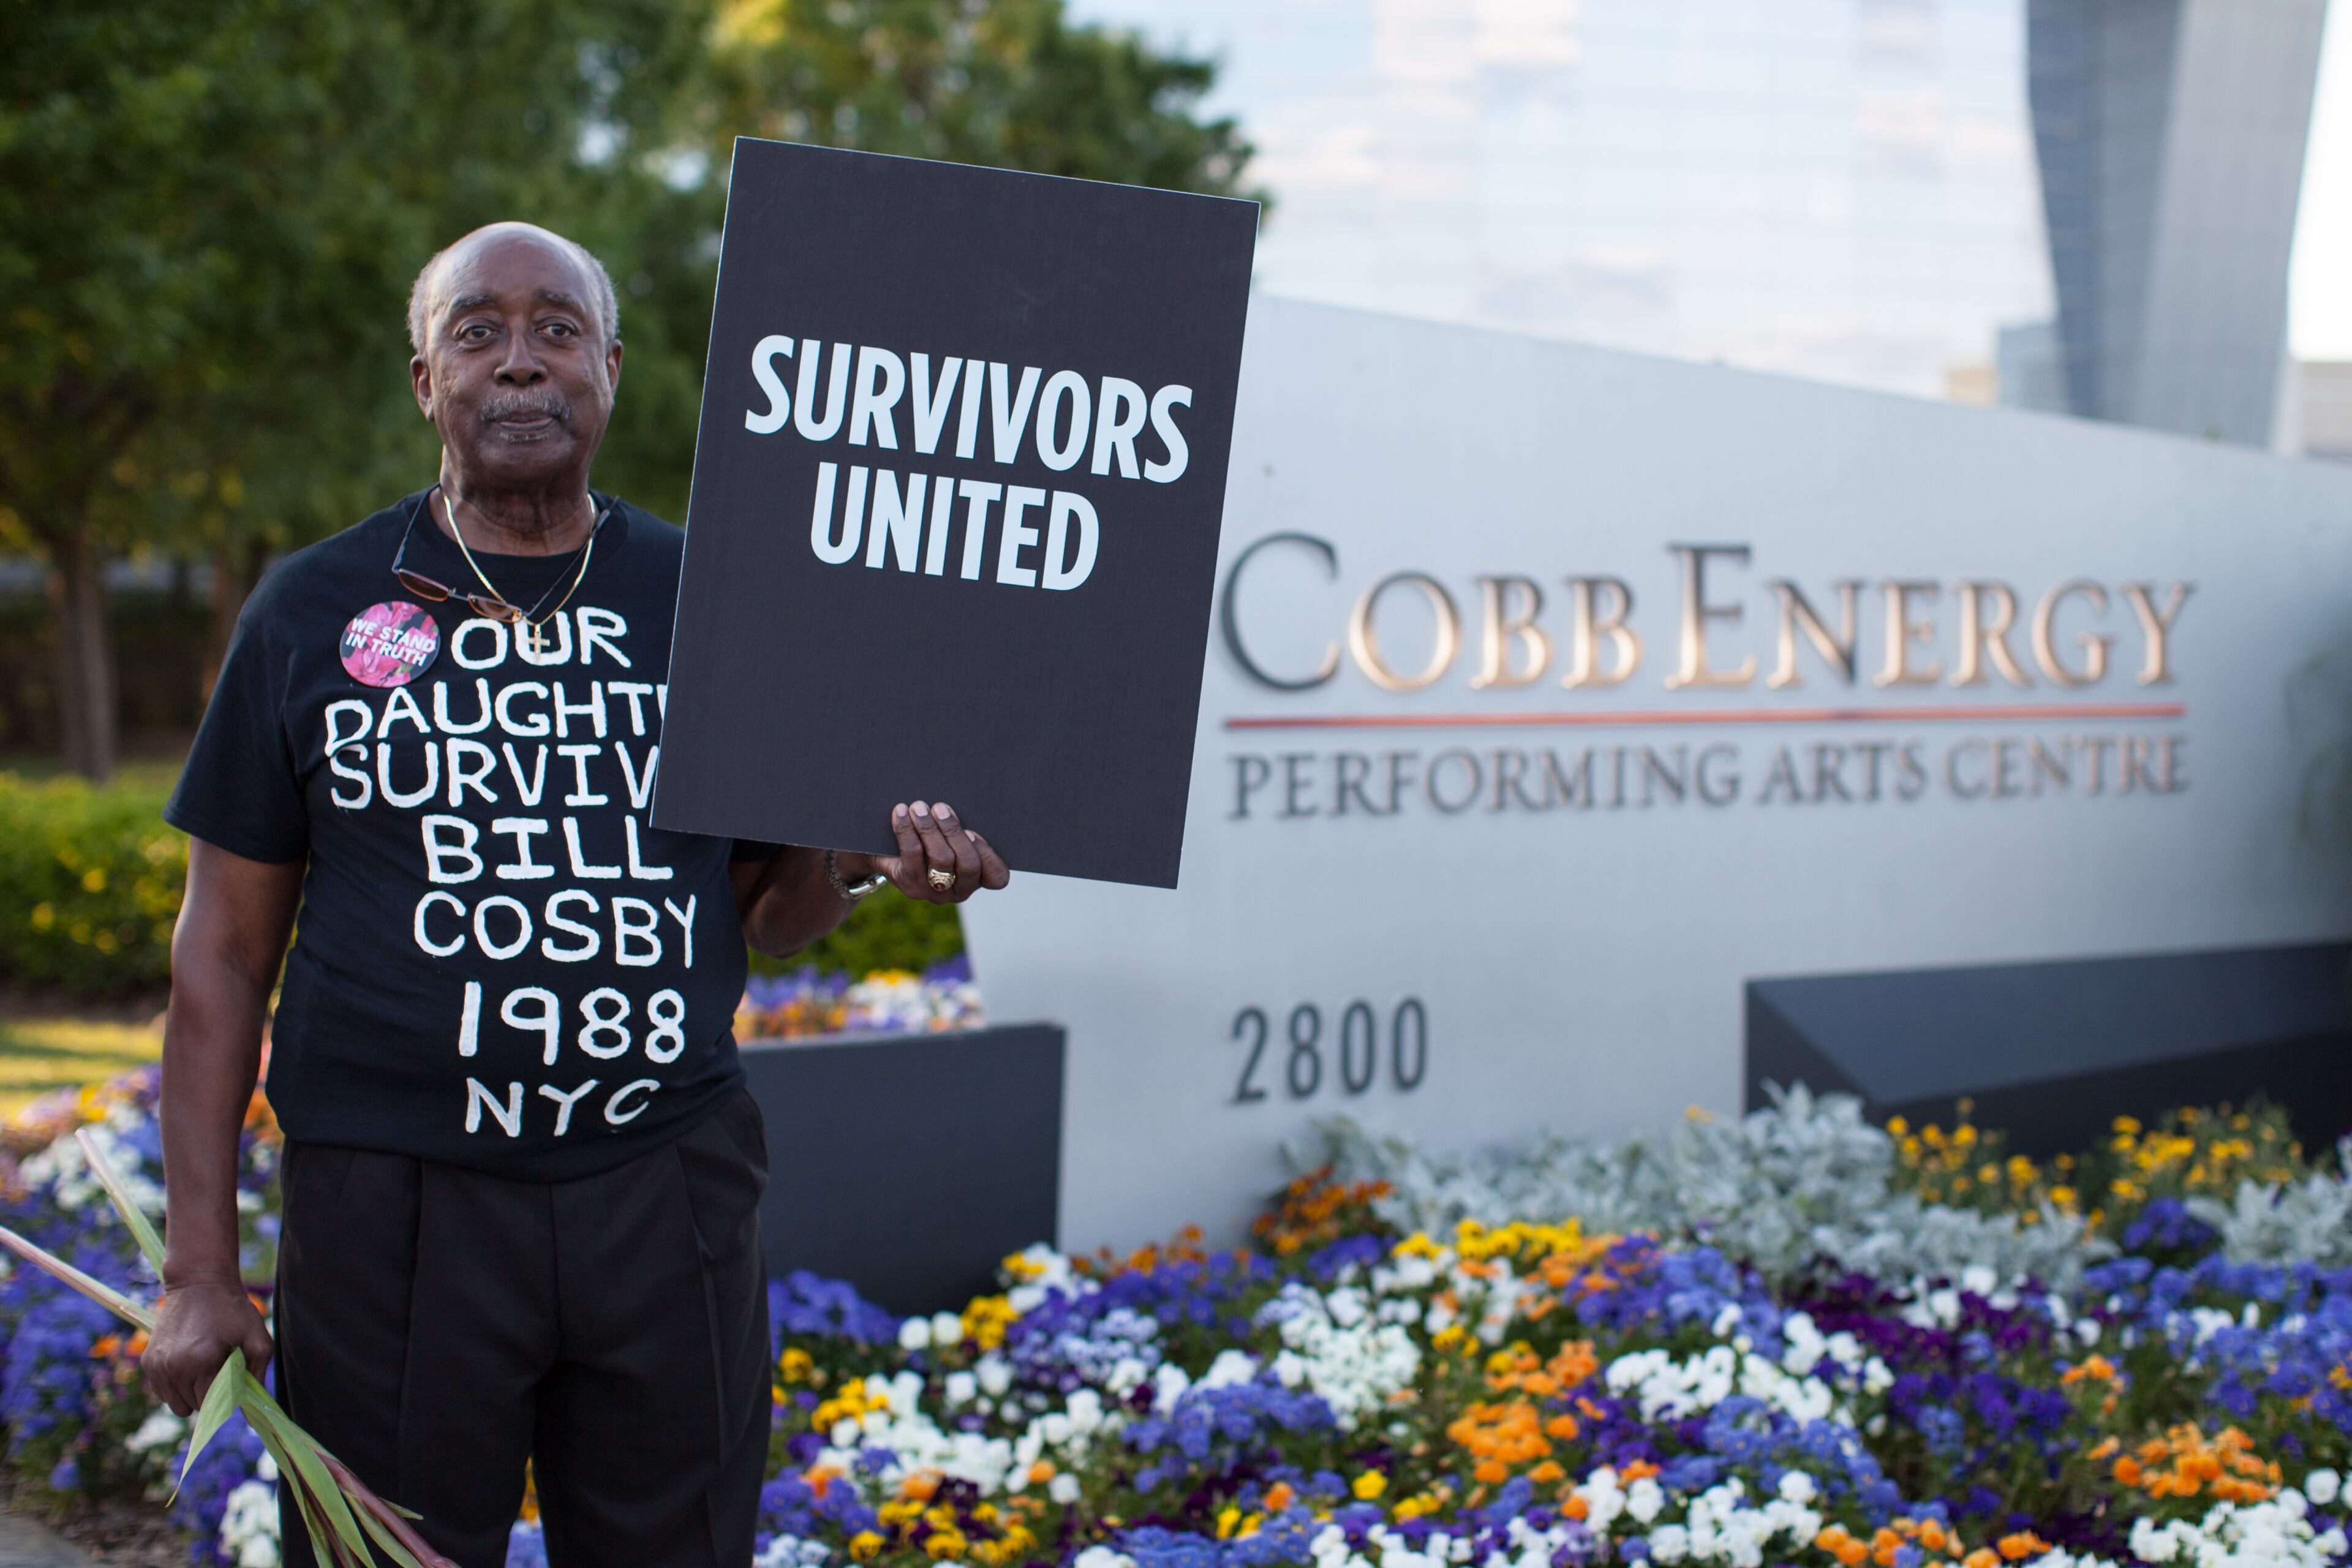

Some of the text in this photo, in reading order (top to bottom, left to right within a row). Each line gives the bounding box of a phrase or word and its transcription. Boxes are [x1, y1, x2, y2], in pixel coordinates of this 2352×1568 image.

[745, 335, 1193, 483] SURVIVORS
[810, 461, 1099, 591] UNITED
[345, 632, 428, 667] IN TRUTH
[351, 617, 437, 654] WE STAND
[451, 606, 631, 669] OUR
[1220, 530, 2197, 692] COBB ENERGY
[325, 677, 668, 757] DAUGHT
[1226, 734, 2192, 820] PERFORMING ARTS CENTRE
[421, 814, 674, 884] BILL
[413, 889, 696, 969] COSBY
[458, 981, 685, 1066] 1988
[1230, 993, 1428, 1104] 2800
[464, 1077, 660, 1138] NYC
